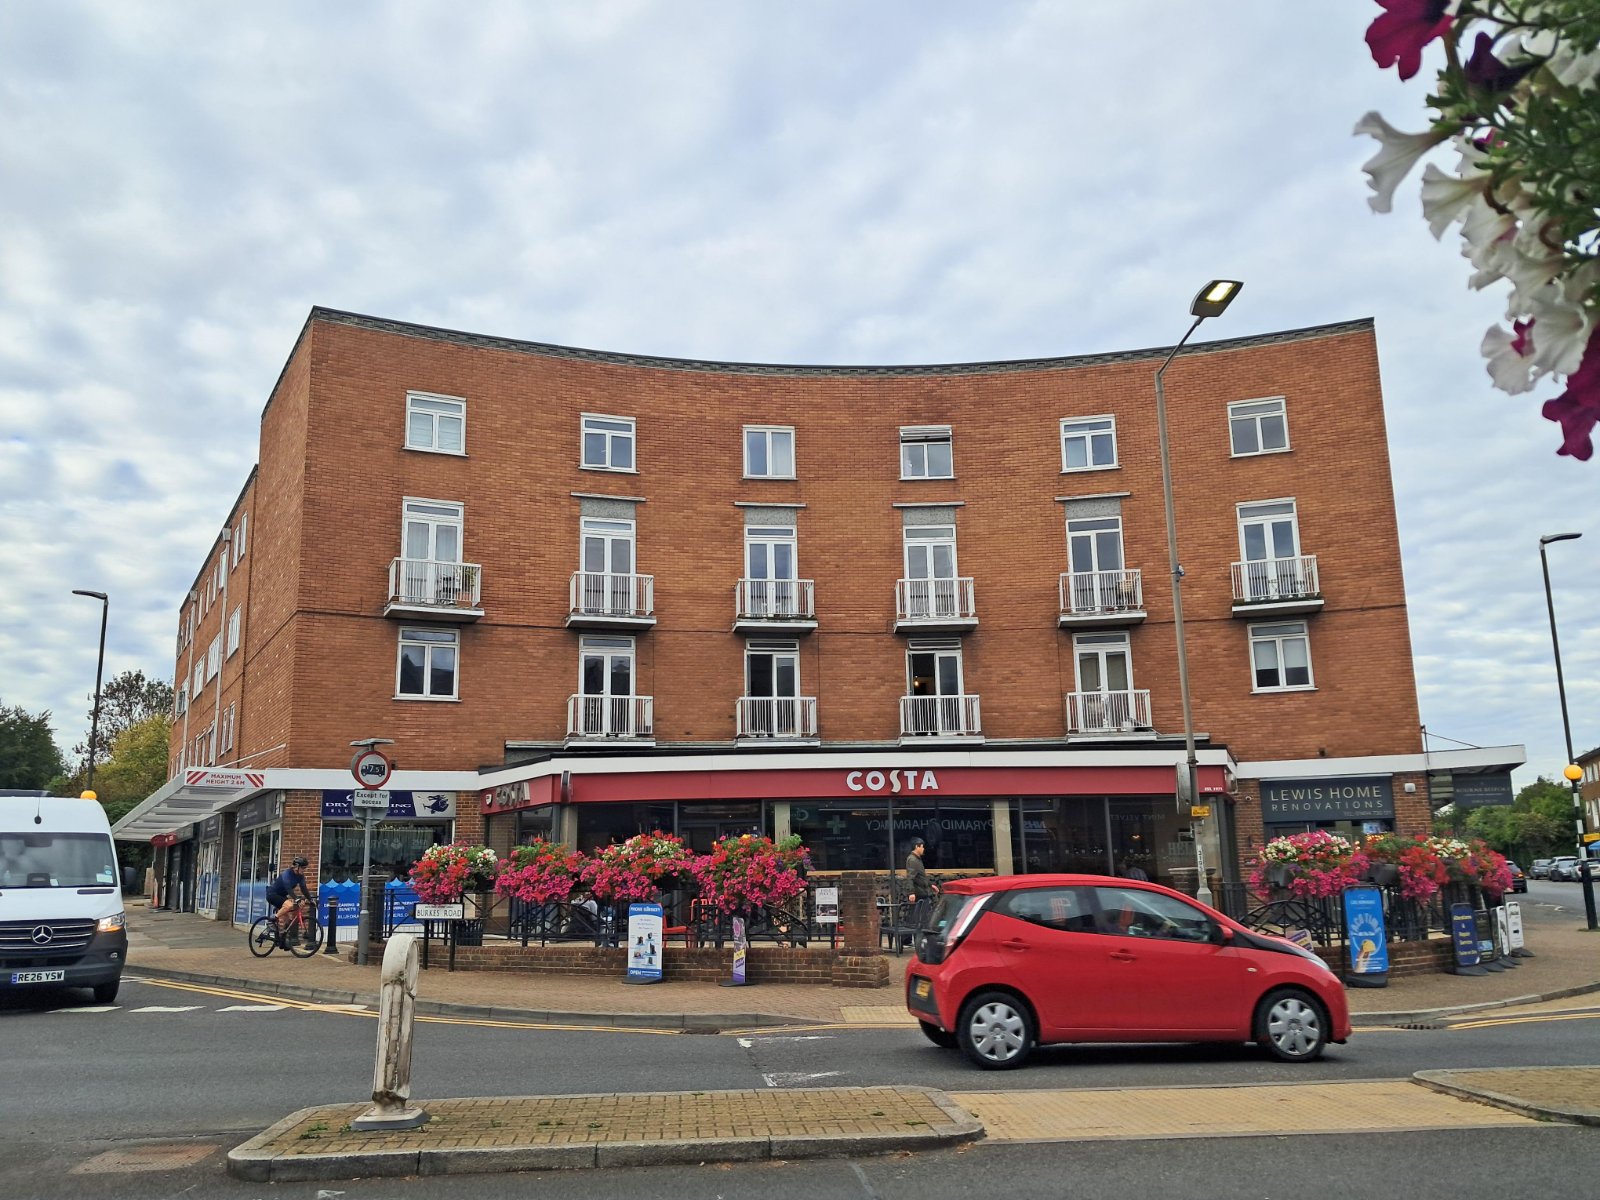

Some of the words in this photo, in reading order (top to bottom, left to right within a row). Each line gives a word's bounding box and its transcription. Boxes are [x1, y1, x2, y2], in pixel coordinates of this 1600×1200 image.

[846, 769, 939, 793] COSTA
[356, 791, 377, 799] Except
[1270, 787, 1323, 801] LEWIS
[1329, 785, 1383, 799] HOME
[1271, 800, 1384, 812] RENOVATIONS
[416, 909, 440, 918] BURKES
[443, 909, 462, 917] ROAD
[17, 972, 43, 982] RE26
[45, 971, 63, 981] YSW
